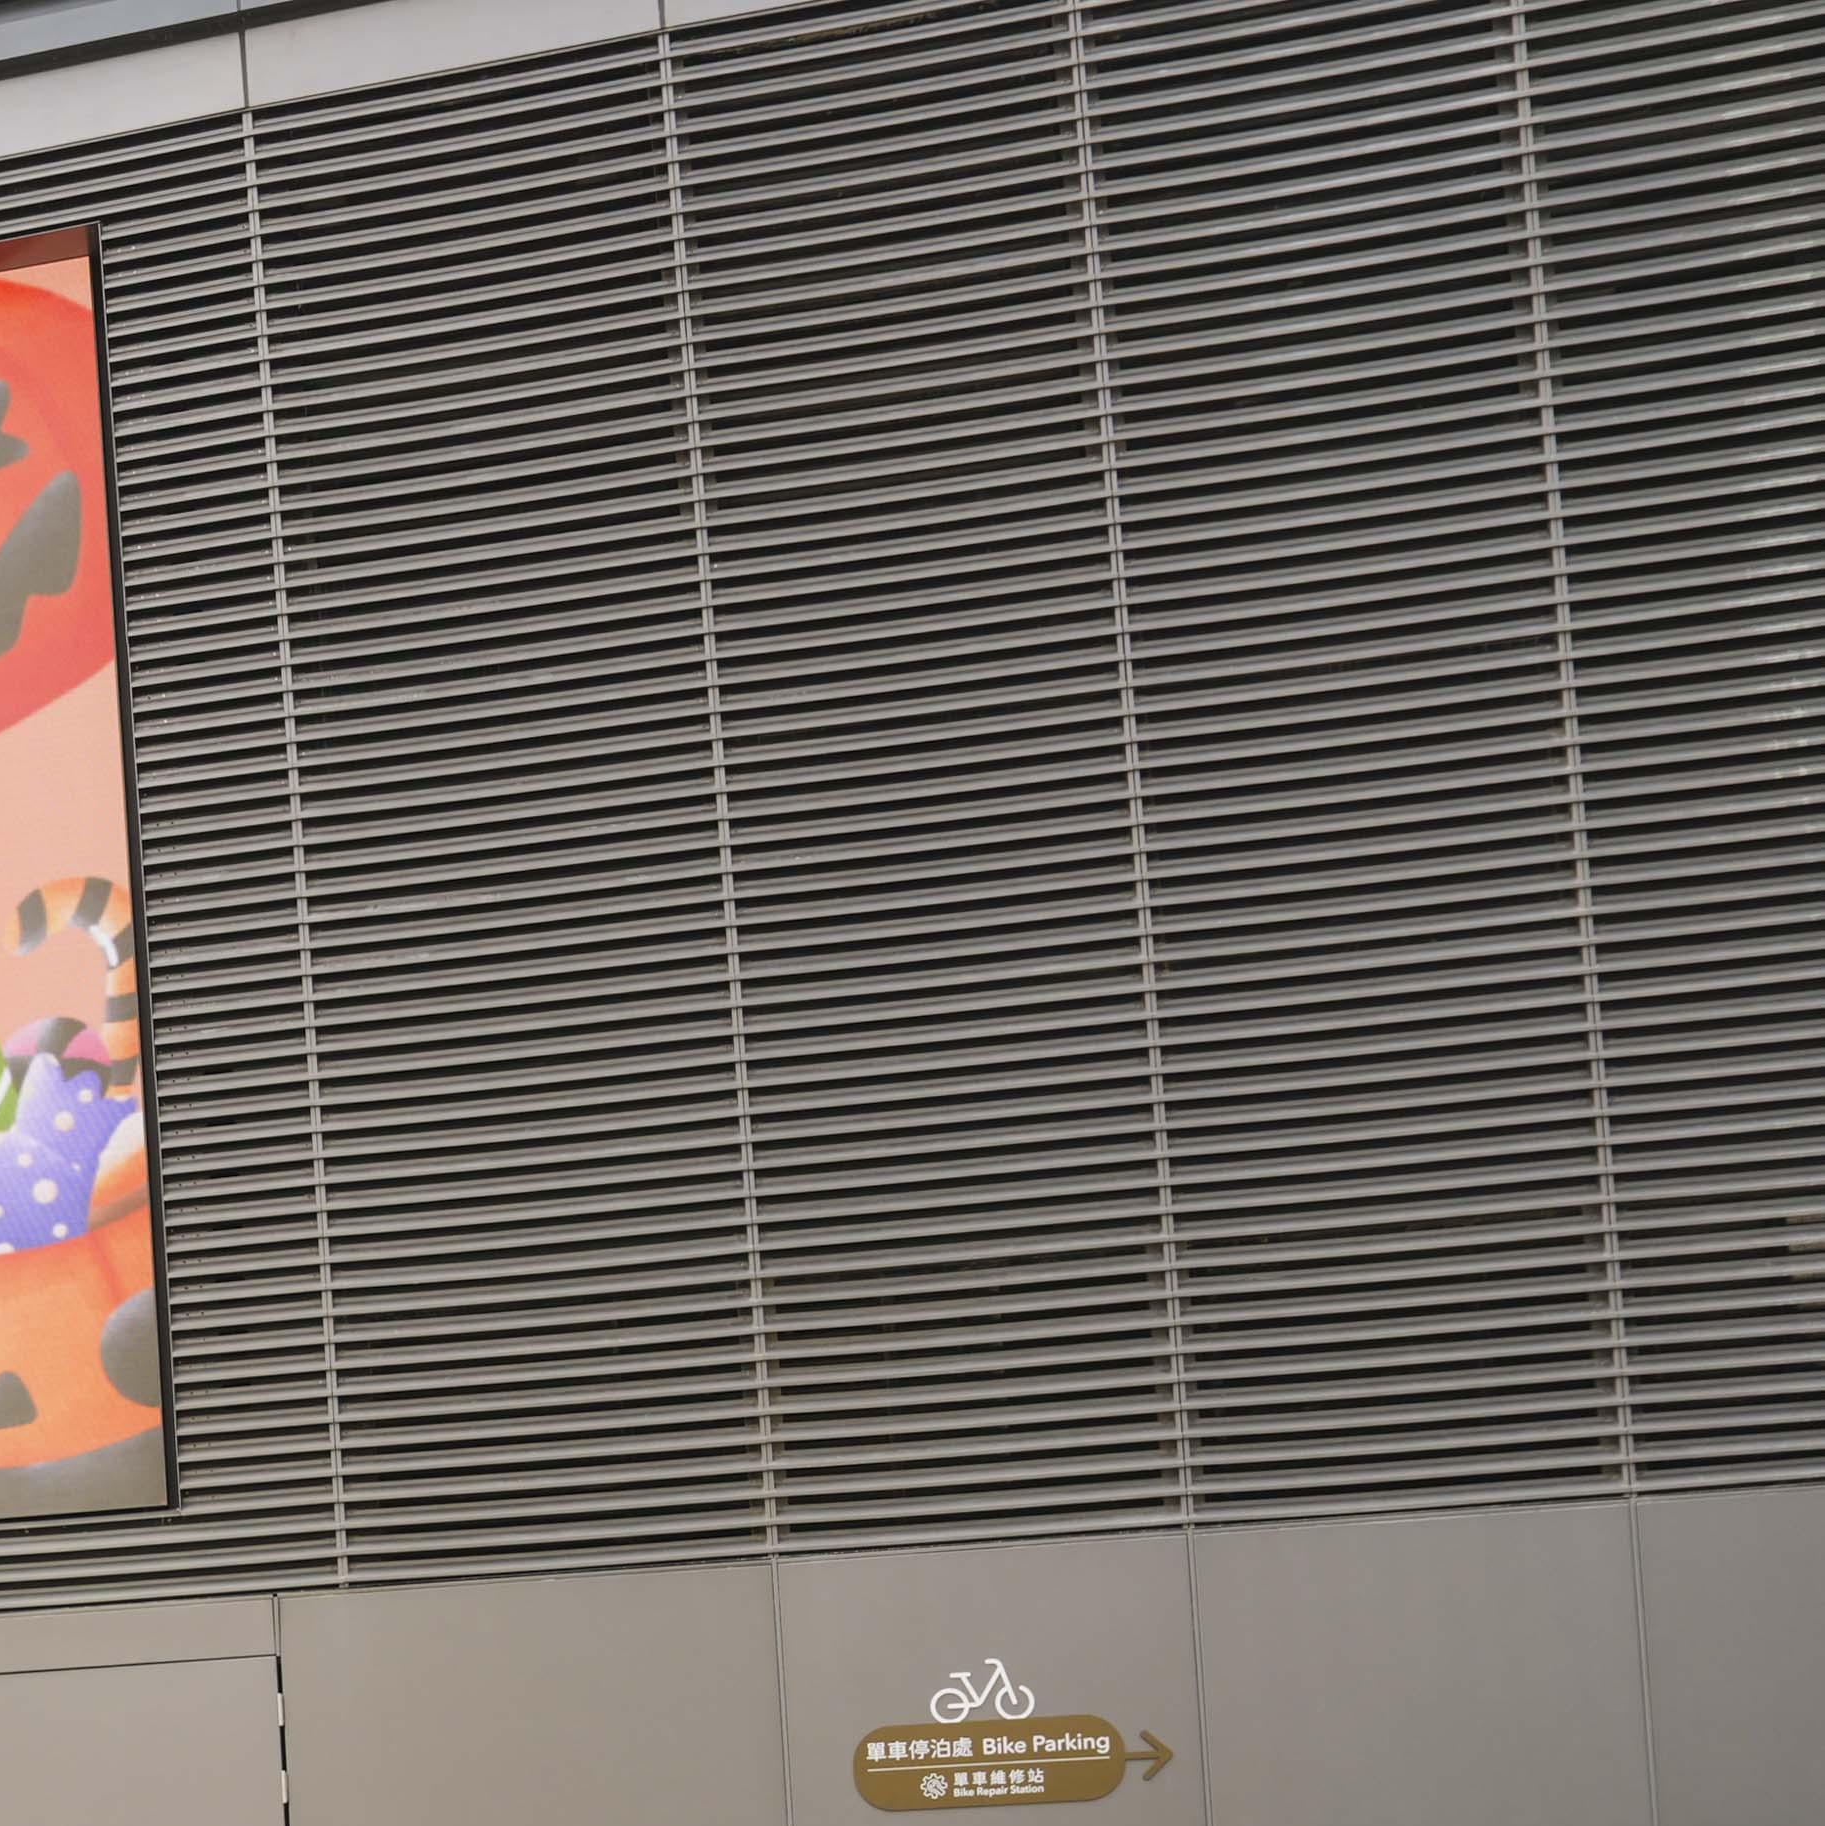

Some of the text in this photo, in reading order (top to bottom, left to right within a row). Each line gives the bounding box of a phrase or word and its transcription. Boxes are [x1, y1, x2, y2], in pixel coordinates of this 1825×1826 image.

[865, 1736, 974, 1762] 單車停泊處
[981, 1731, 1111, 1756] Bike Parking
[953, 1784, 1045, 1798] Bike Repair Station
